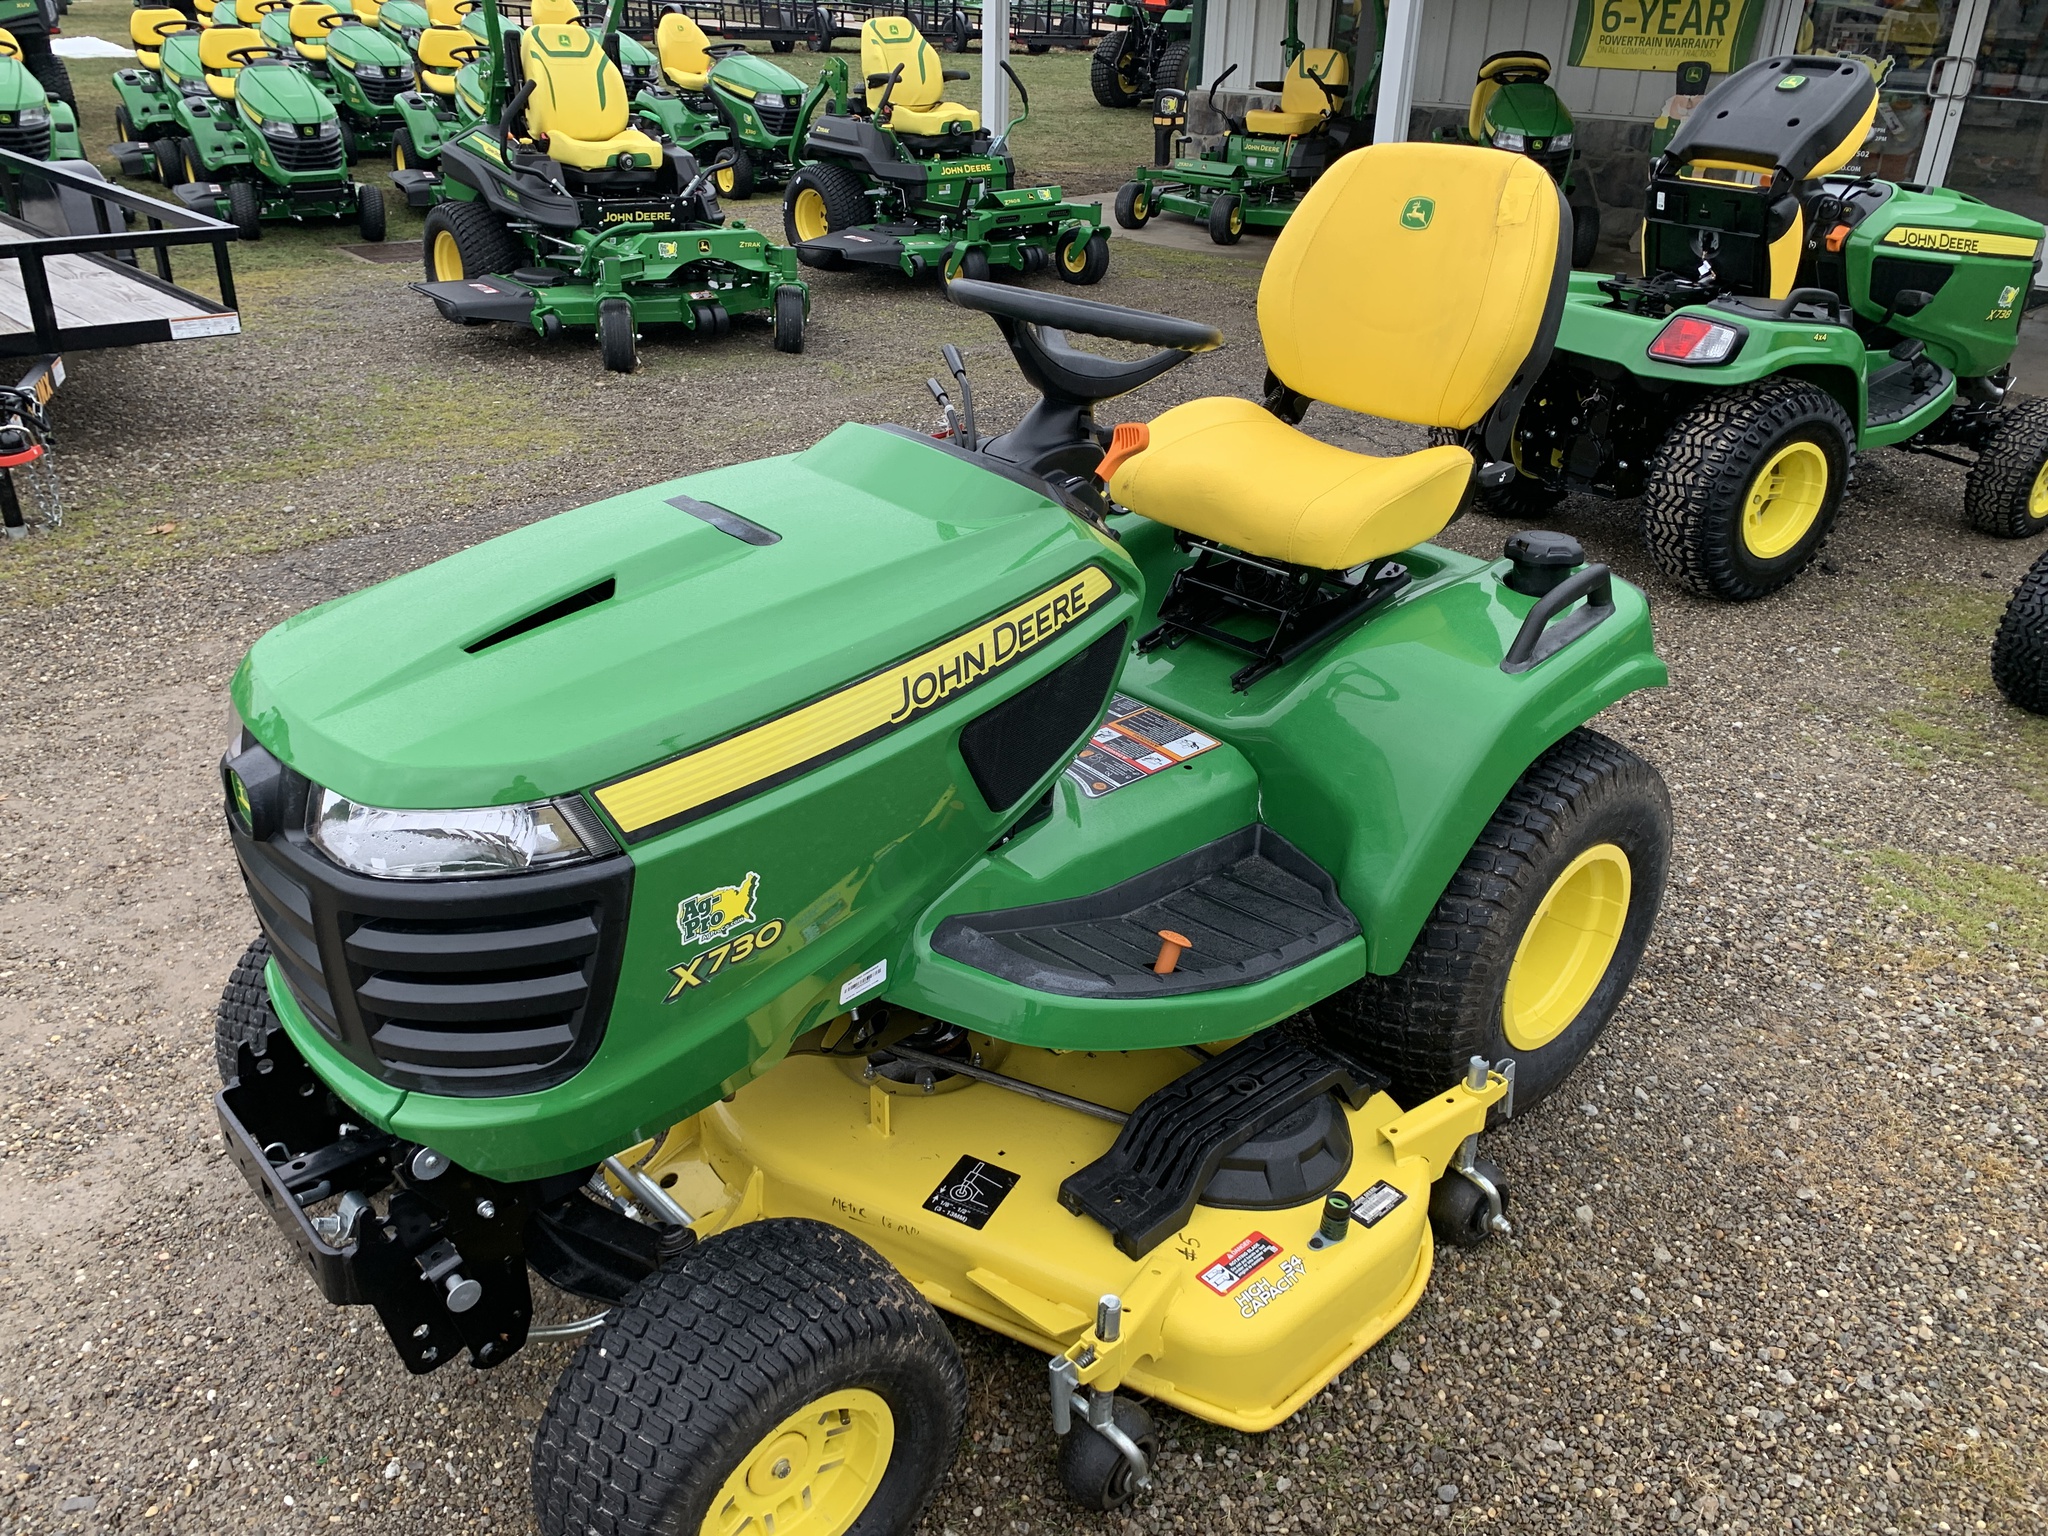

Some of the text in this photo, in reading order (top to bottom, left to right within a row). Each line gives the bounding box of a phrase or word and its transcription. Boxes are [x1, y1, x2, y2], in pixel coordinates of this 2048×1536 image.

[1601, 0, 1731, 36] 6-YEAR
[1597, 46, 1717, 58] ON ALL COMPACT UTILITY TRACTORS
[1599, 34, 1723, 50] POWERTRAIN WARRANTY
[1244, 143, 1280, 153] JOHN DEERE
[941, 164, 992, 175] JOHN DEERE
[603, 211, 671, 222] JOHN DEERE
[1898, 229, 1979, 252] JOHN DEERE
[1986, 309, 2013, 321] X738
[1813, 333, 1827, 341] 4x4
[891, 581, 1087, 721] JOHN DEERE
[683, 894, 722, 923] Ag-
[684, 911, 724, 940] Pro
[664, 919, 784, 1001] X730
[1230, 1238, 1252, 1256] DANGER
[1234, 1254, 1303, 1307] HIGH 54
[1240, 1263, 1307, 1319] CAPACITY
